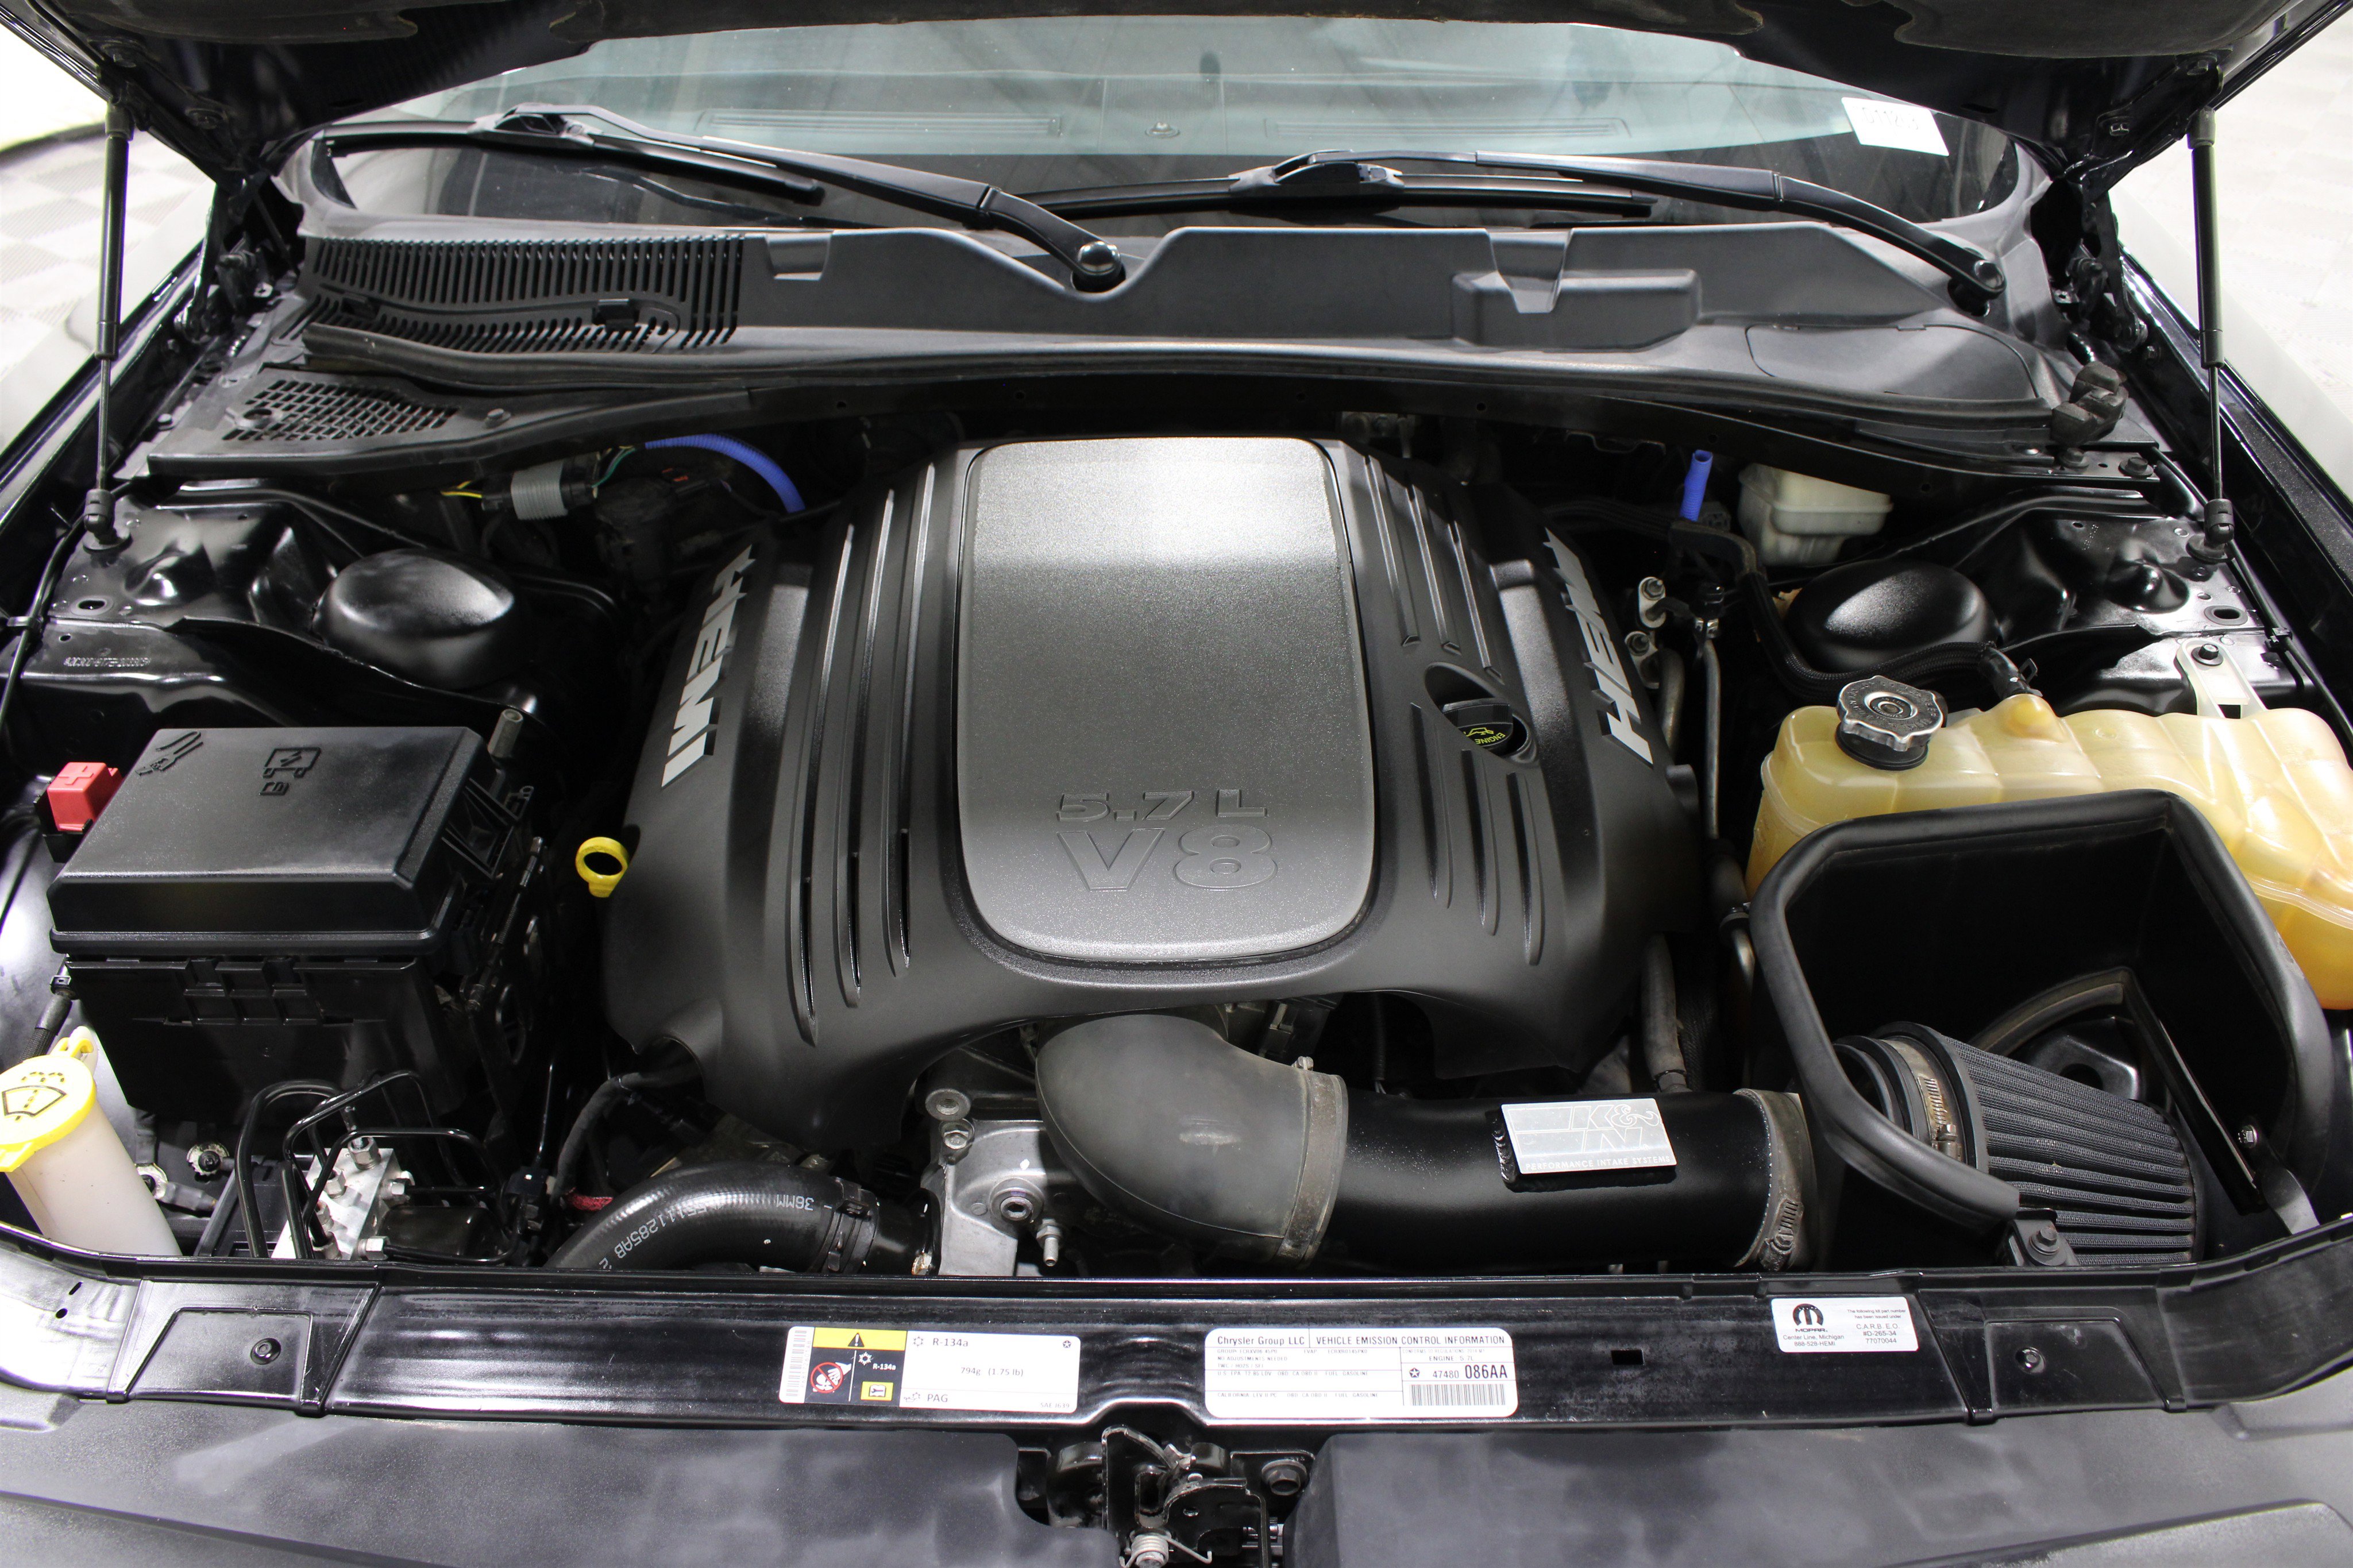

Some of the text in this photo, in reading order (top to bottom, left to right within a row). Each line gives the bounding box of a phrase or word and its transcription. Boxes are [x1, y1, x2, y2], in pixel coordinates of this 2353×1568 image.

[661, 544, 756, 788] HEMI
[1475, 732, 1506, 745] ENGINE
[1056, 824, 1278, 892] V8
[1525, 1155, 1671, 1171] PERFORMANCE INTAKE SYSTEMS
[932, 1337, 969, 1347] R-134a
[1217, 1335, 1305, 1346] Chrysler Group LLC
[1316, 1335, 1505, 1345] VEHICLE EMISSION CONTROL INFORMATION
[873, 1362, 897, 1371] R-134a
[960, 1366, 1024, 1377] 794g (1.75 lb)
[1432, 1364, 1509, 1380] 47480 086AA
[927, 1393, 948, 1403] PAG
